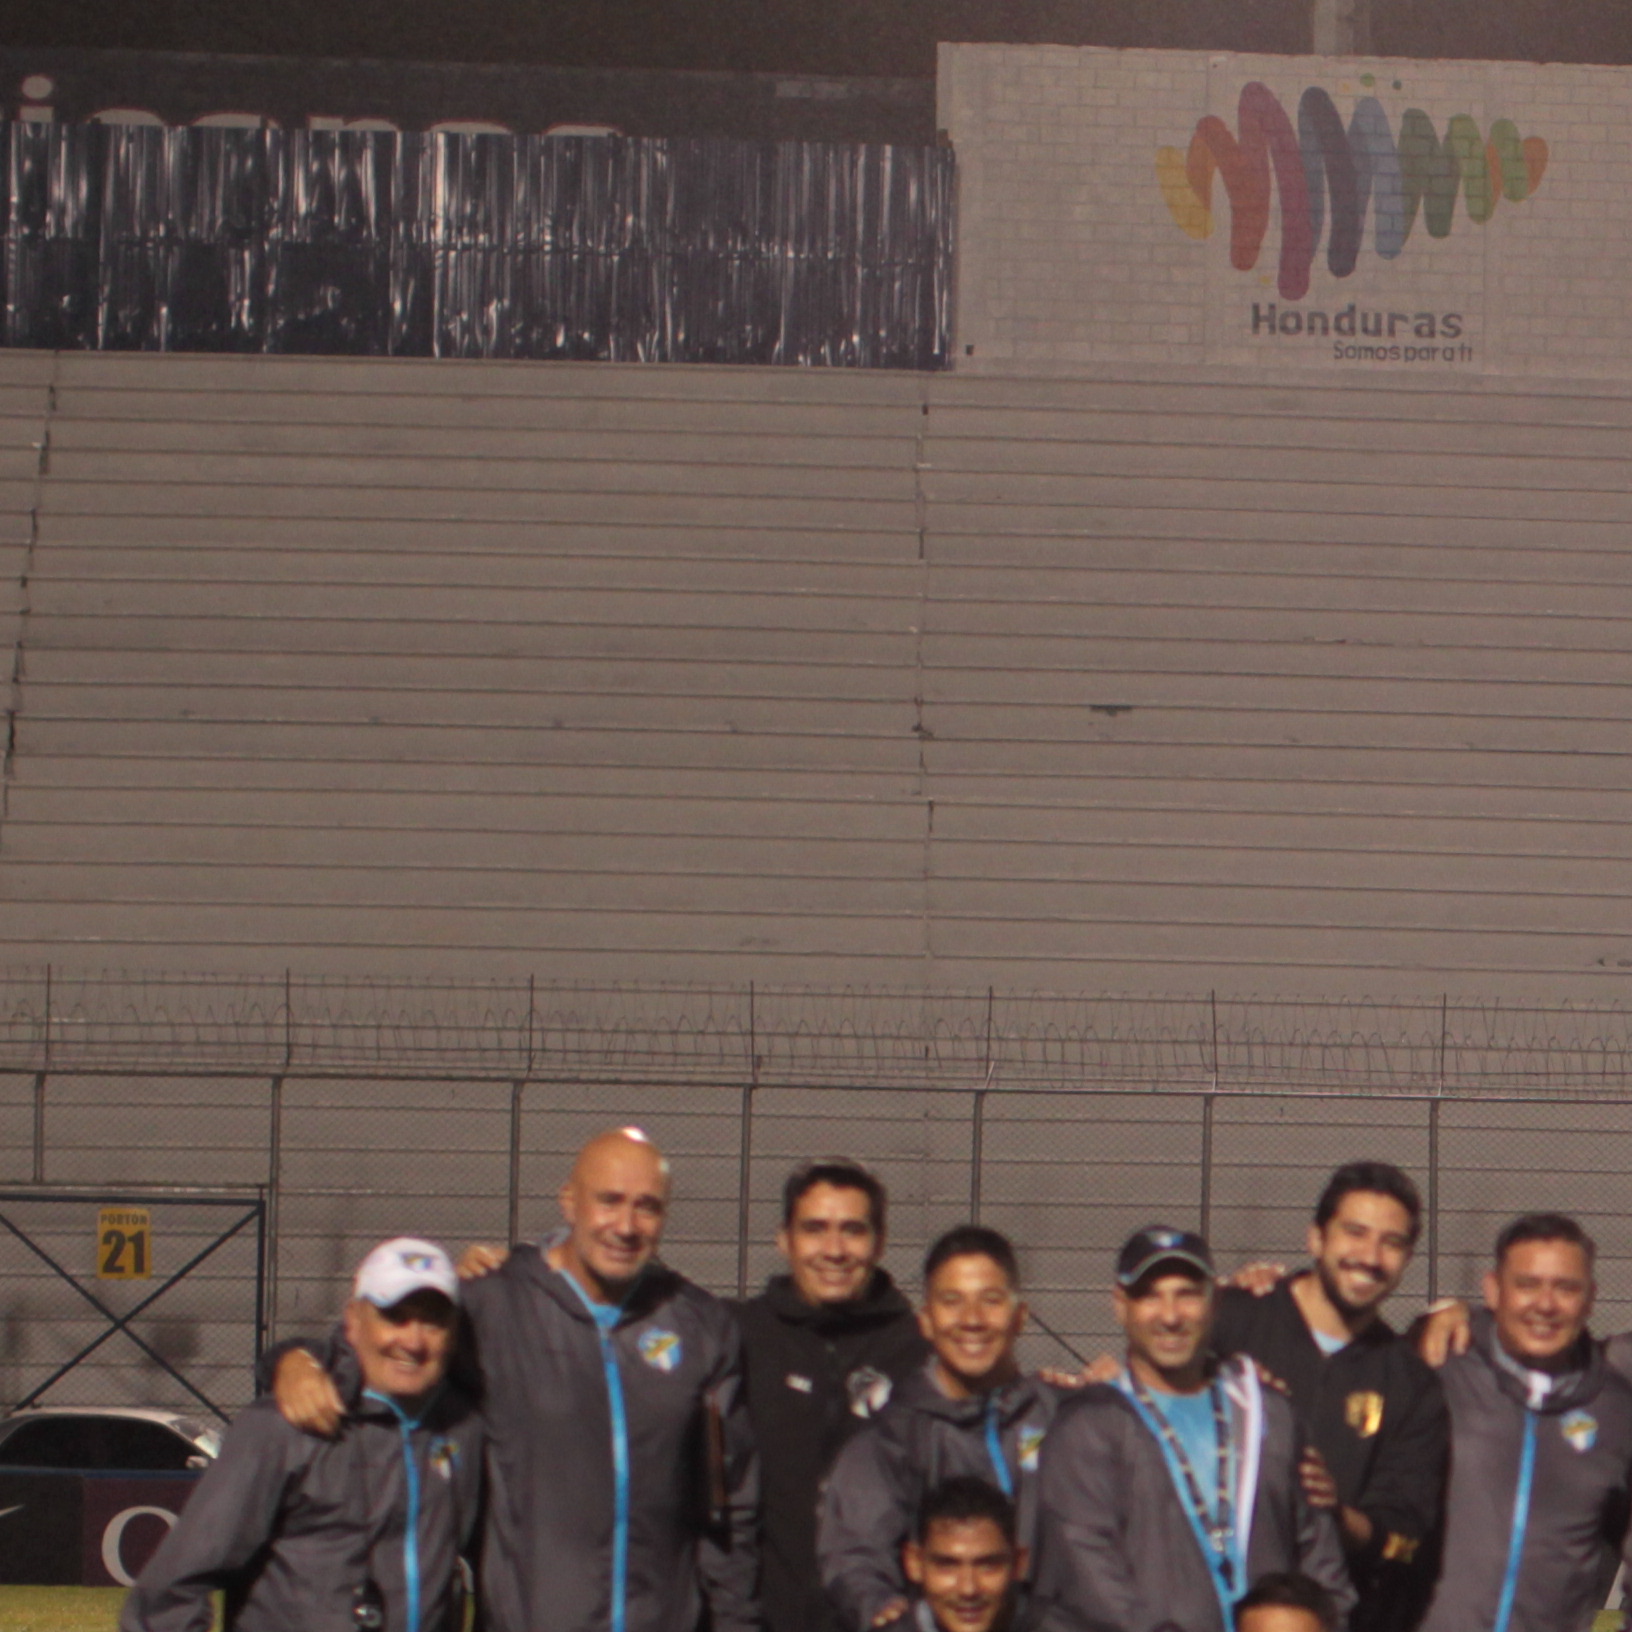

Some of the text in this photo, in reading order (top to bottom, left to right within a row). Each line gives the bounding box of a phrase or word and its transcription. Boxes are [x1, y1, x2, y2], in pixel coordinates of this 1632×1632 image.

[1252, 303, 1463, 339] Honduras
[1333, 341, 1400, 361] Somos
[1404, 344, 1455, 362] para
[102, 1230, 145, 1273] 21
